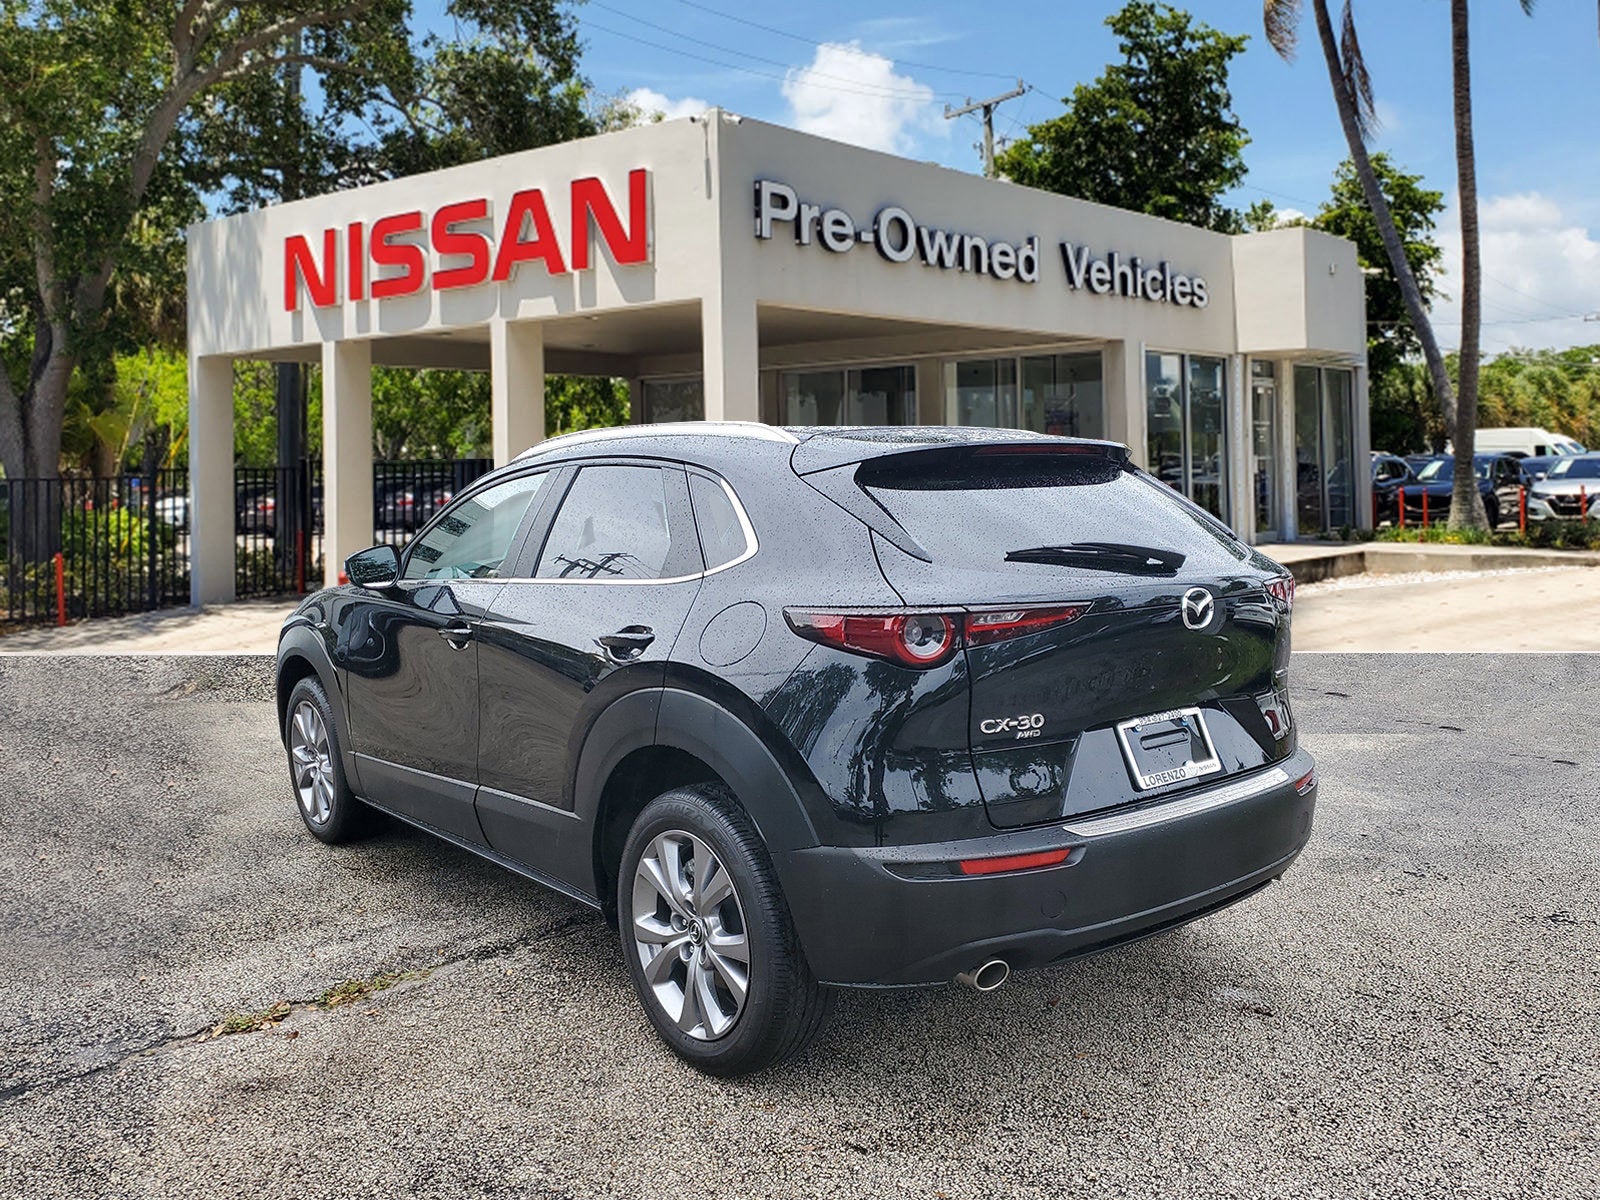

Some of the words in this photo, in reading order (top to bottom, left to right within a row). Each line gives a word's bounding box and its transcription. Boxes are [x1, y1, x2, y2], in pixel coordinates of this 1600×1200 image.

[284, 168, 648, 312] NISSAN
[754, 179, 1040, 284] Pre-Owned
[1061, 240, 1209, 309] Vehicles
[980, 713, 1045, 734] CX-30
[1016, 729, 1041, 740] AWD
[1142, 768, 1186, 788] LORENZO
